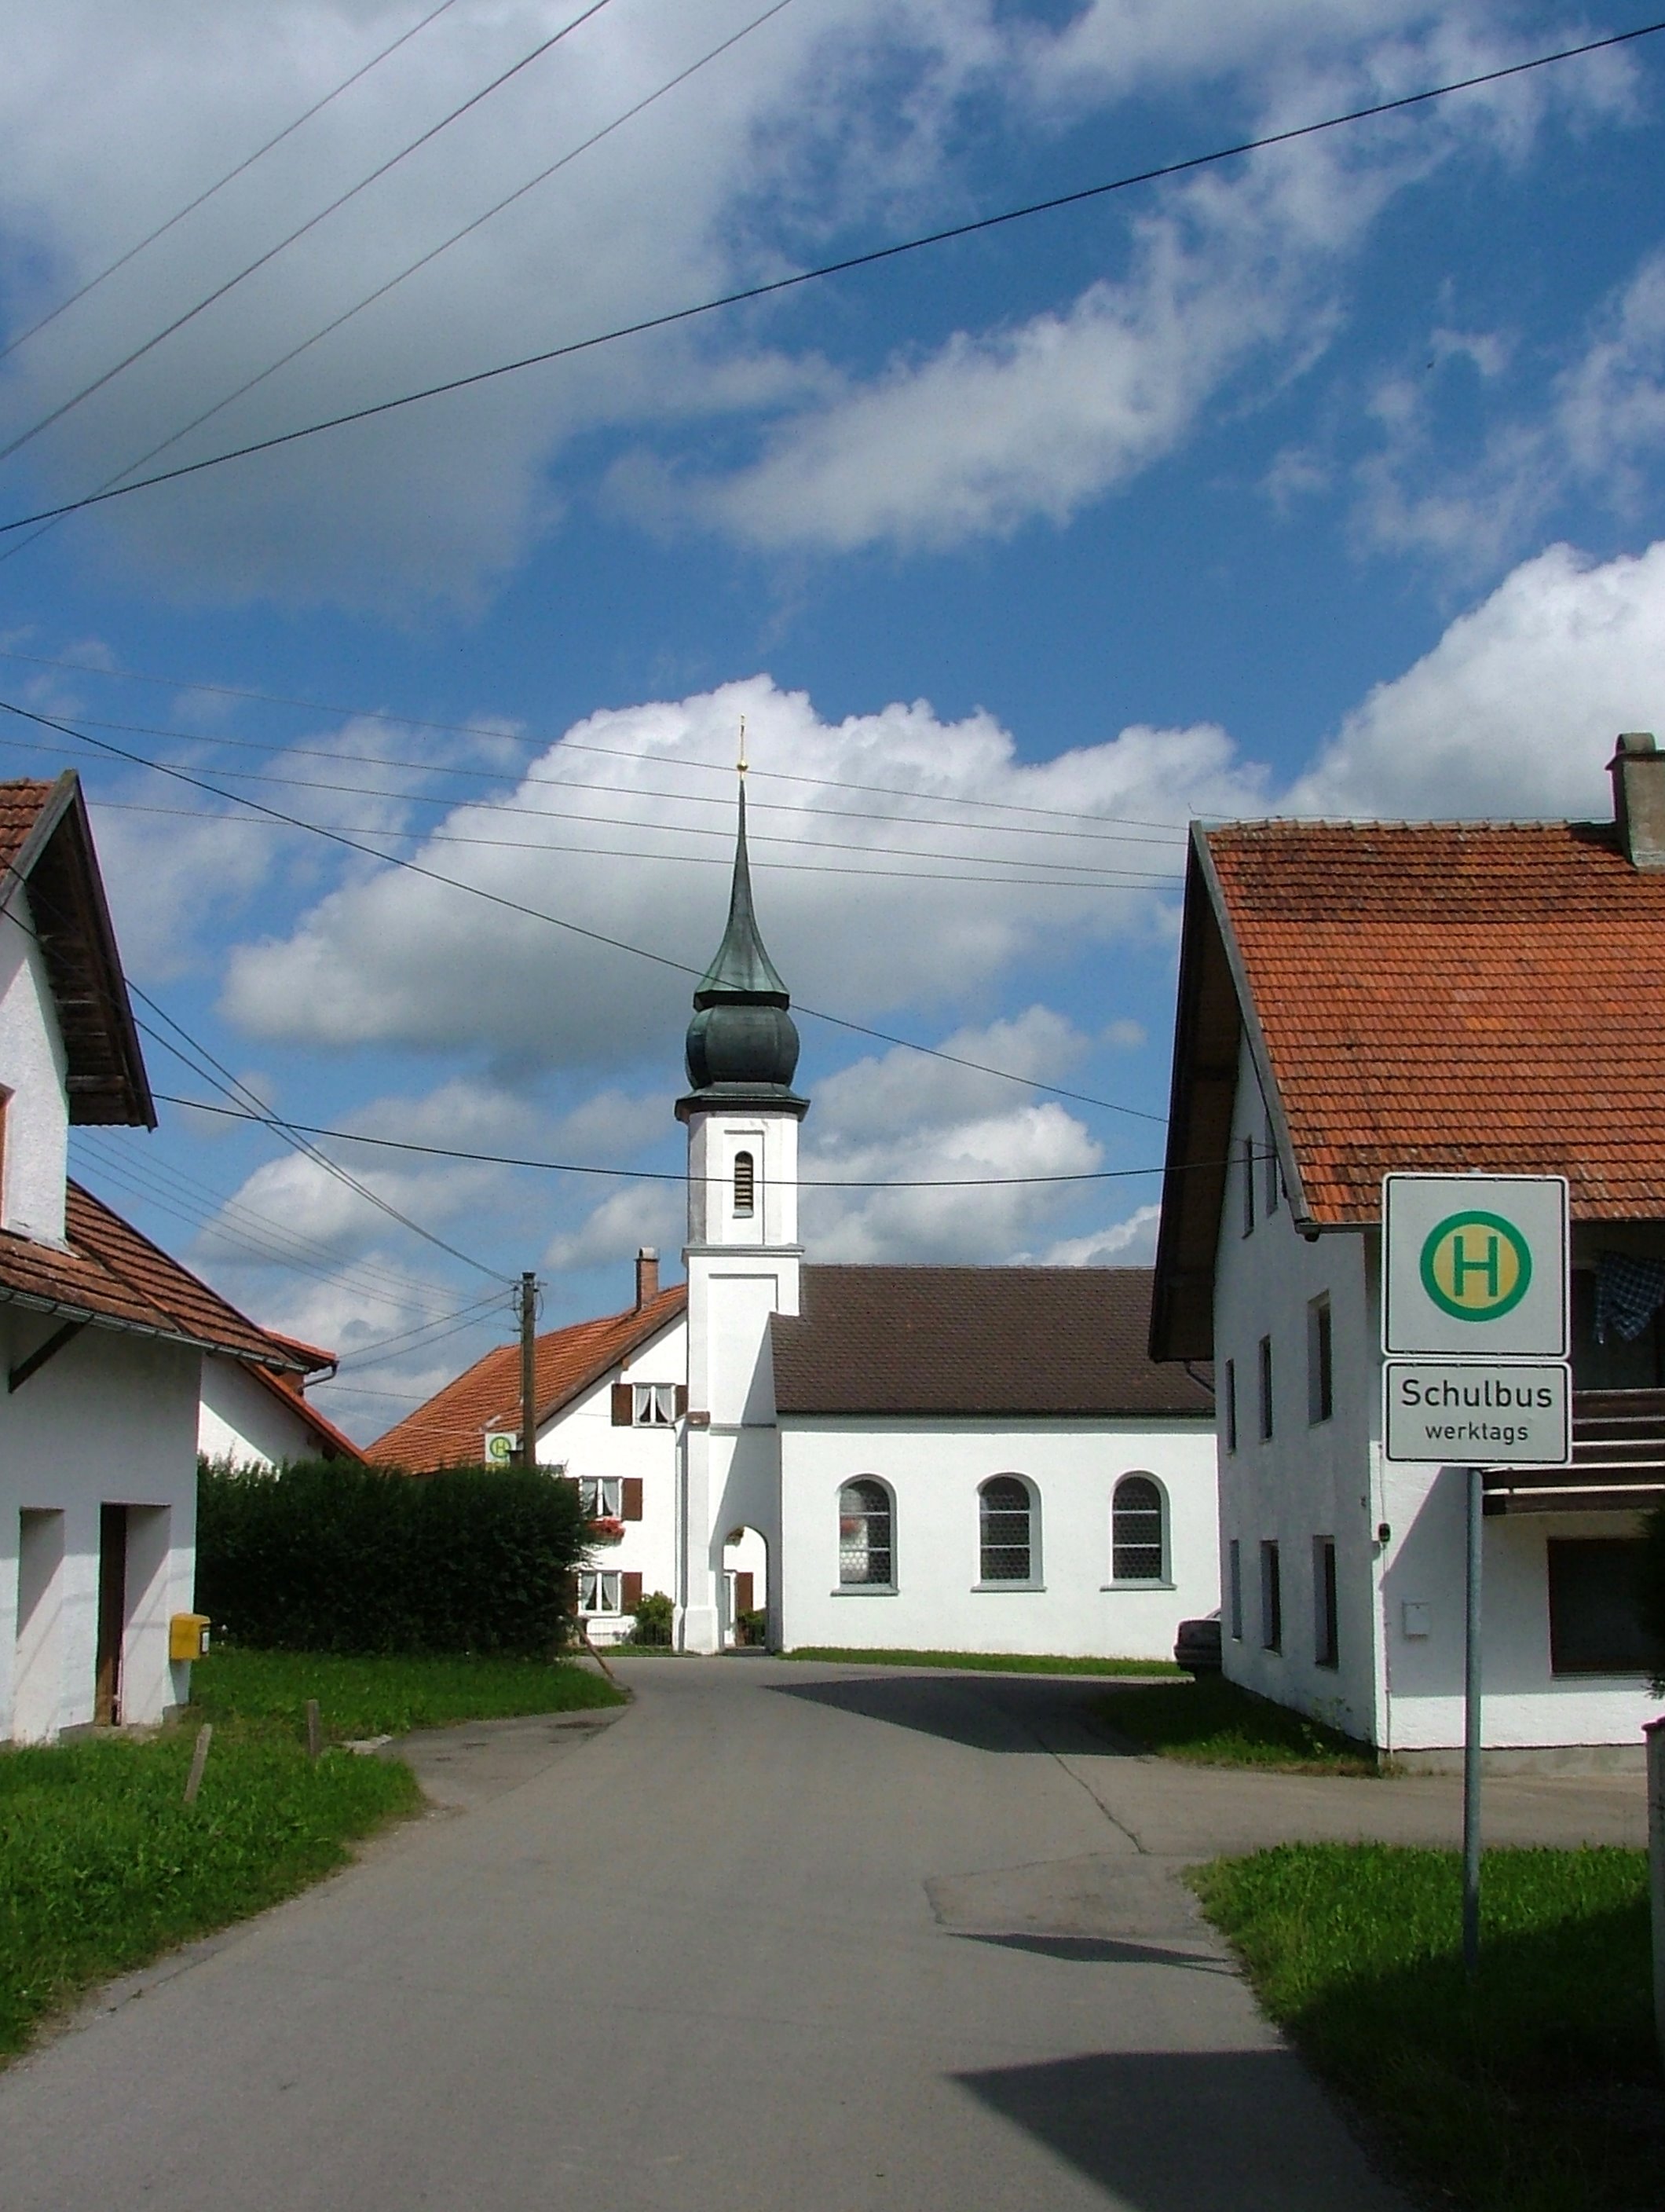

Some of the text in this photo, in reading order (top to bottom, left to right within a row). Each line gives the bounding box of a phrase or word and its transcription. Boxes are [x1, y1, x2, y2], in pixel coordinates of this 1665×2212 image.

[1453, 1236, 1498, 1297] H
[1401, 1379, 1552, 1408] Schulbus
[1425, 1423, 1528, 1445] werktags
[496, 1441, 506, 1454] H
